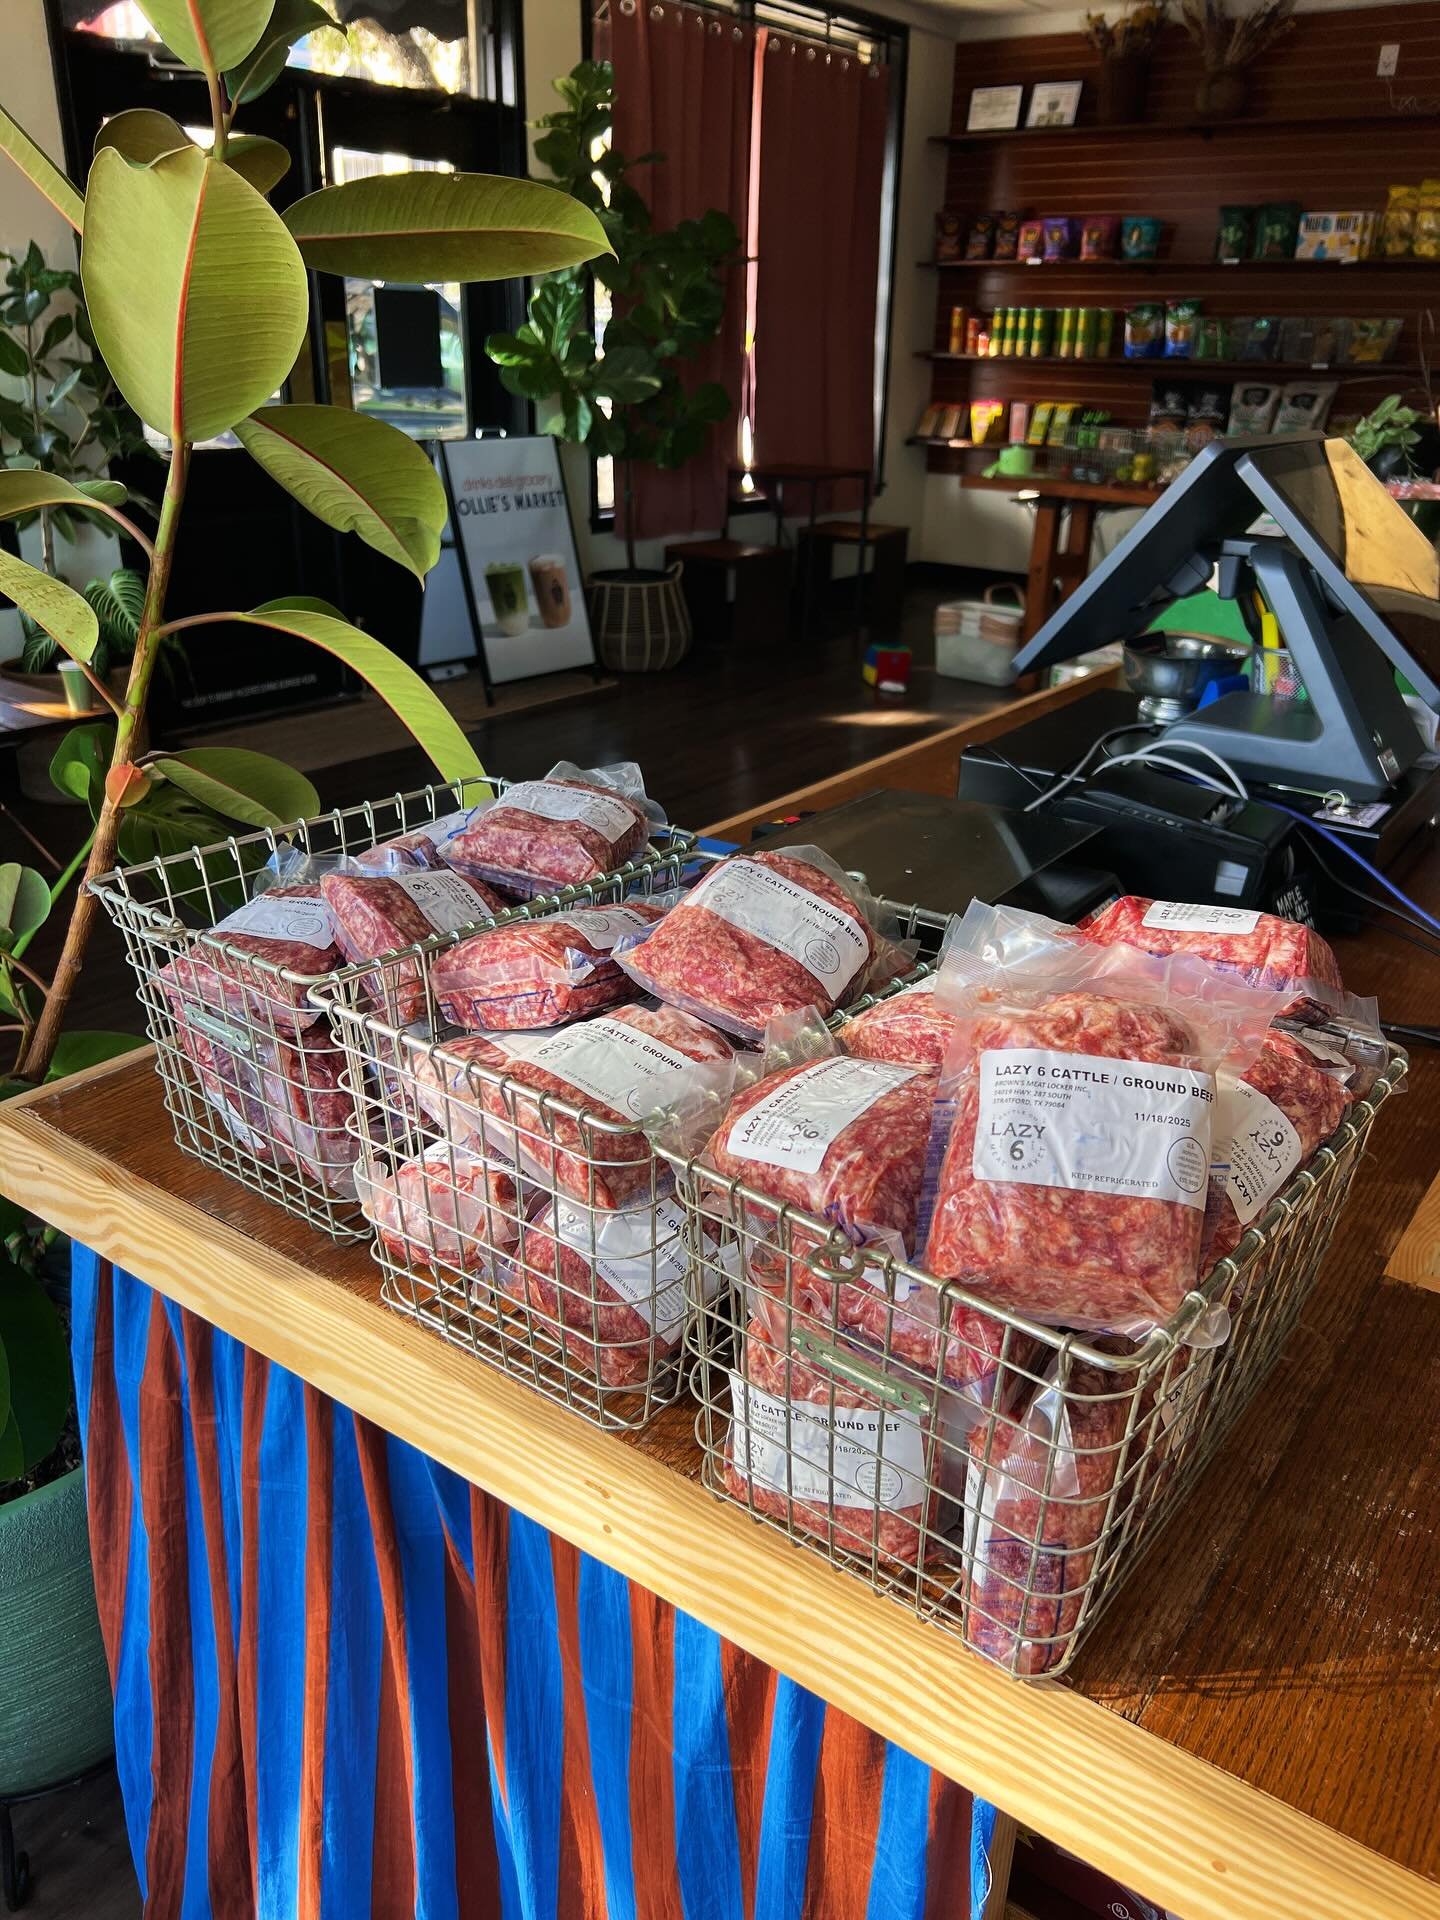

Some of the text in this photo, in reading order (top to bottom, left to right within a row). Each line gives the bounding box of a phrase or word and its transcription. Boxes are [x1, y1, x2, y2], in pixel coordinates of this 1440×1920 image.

[458, 491, 563, 516] OLLIE'S MARKET
[764, 877, 801, 899] CATTLE
[806, 900, 845, 927] GROUND
[602, 1026, 637, 1046] CATTLE
[643, 1045, 682, 1070] GROUND
[996, 1065, 1032, 1076] LAZY
[1037, 1066, 1046, 1077] 6
[1051, 1068, 1110, 1084] CATTLE
[1123, 1076, 1187, 1095] GROUND
[1026, 1081, 1046, 1089] MEAT
[1047, 1083, 1073, 1091] LOCKER
[1047, 1092, 1072, 1101] SOUTH
[741, 1115, 762, 1143] LAZY
[769, 1082, 804, 1108] CATTLE
[1134, 1112, 1192, 1128] 11/18/2025
[781, 1118, 813, 1152] LAZY
[803, 1128, 820, 1139] 6
[991, 1122, 1046, 1139] LAZY
[1269, 1131, 1284, 1147] 6
[1010, 1140, 1024, 1161] 6
[1249, 1130, 1282, 1173] LAZY
[1071, 1171, 1158, 1189] KEEP REFRIGERATED
[1231, 1175, 1253, 1206] LAZY
[753, 1400, 759, 1409] 6
